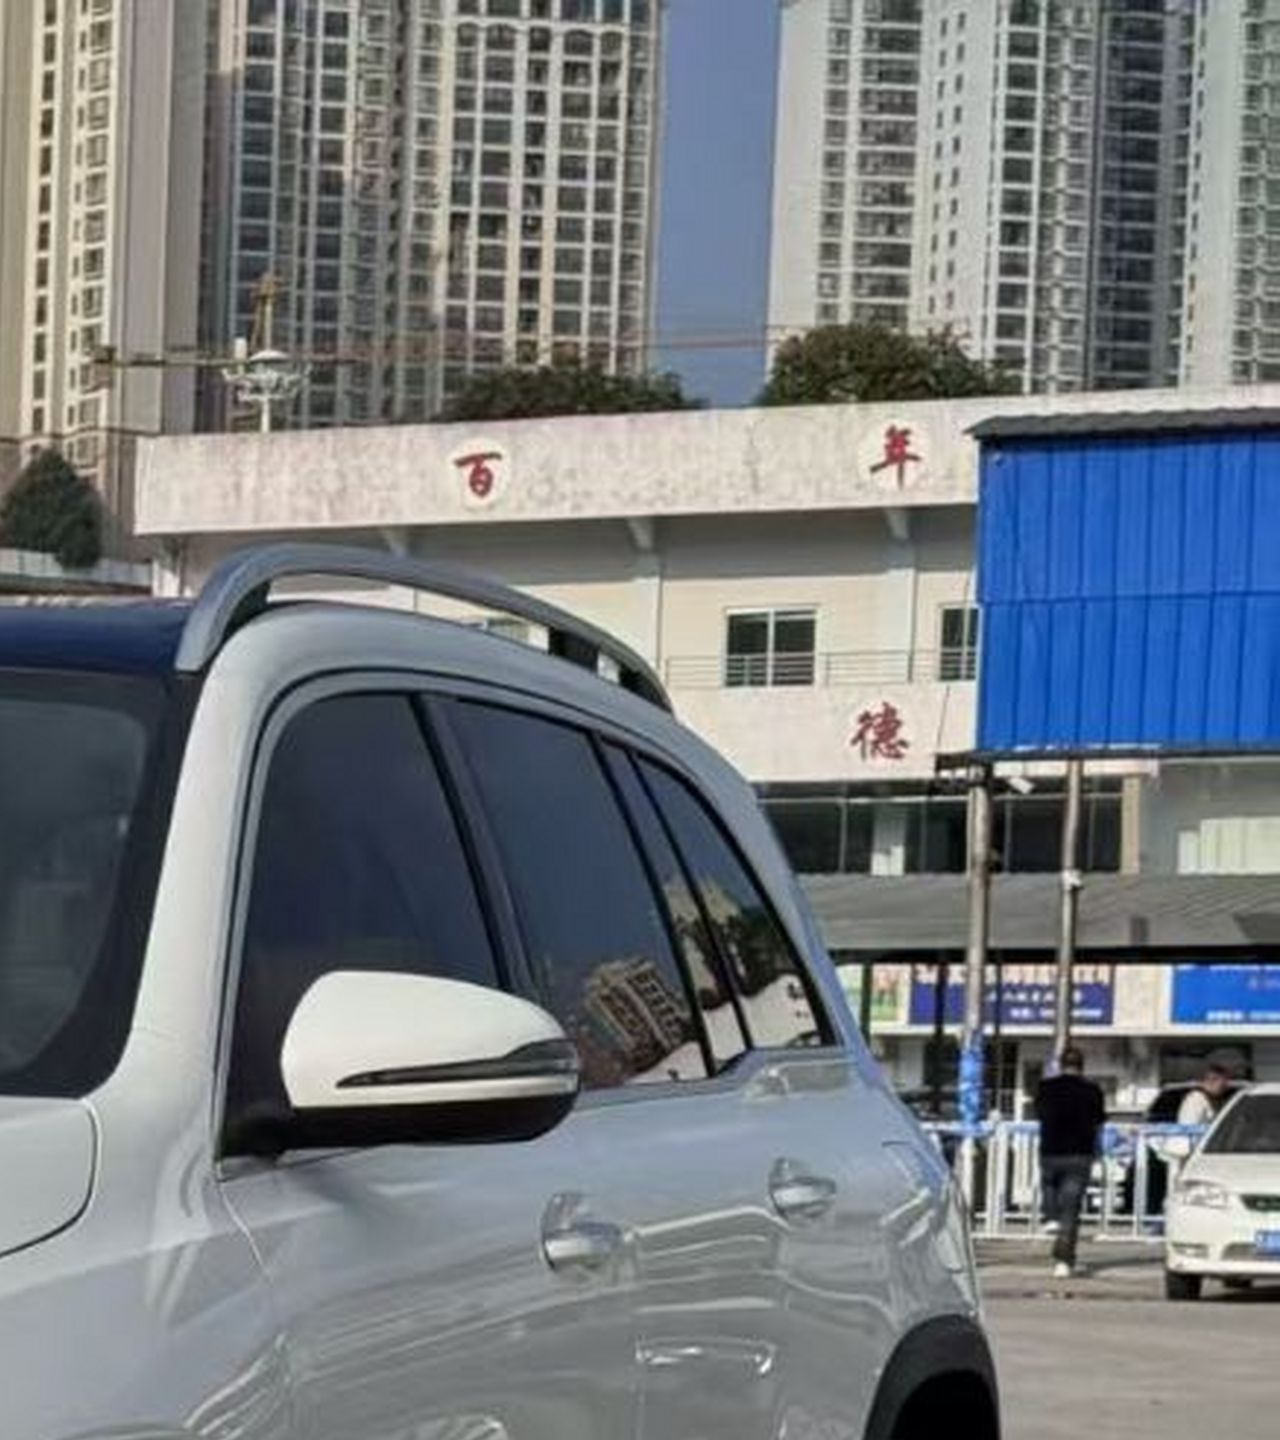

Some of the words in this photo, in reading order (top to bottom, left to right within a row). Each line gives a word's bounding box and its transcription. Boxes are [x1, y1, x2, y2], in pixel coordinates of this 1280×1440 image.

[453, 452, 503, 497] 百
[870, 425, 922, 488] 年
[851, 701, 909, 761] 德
